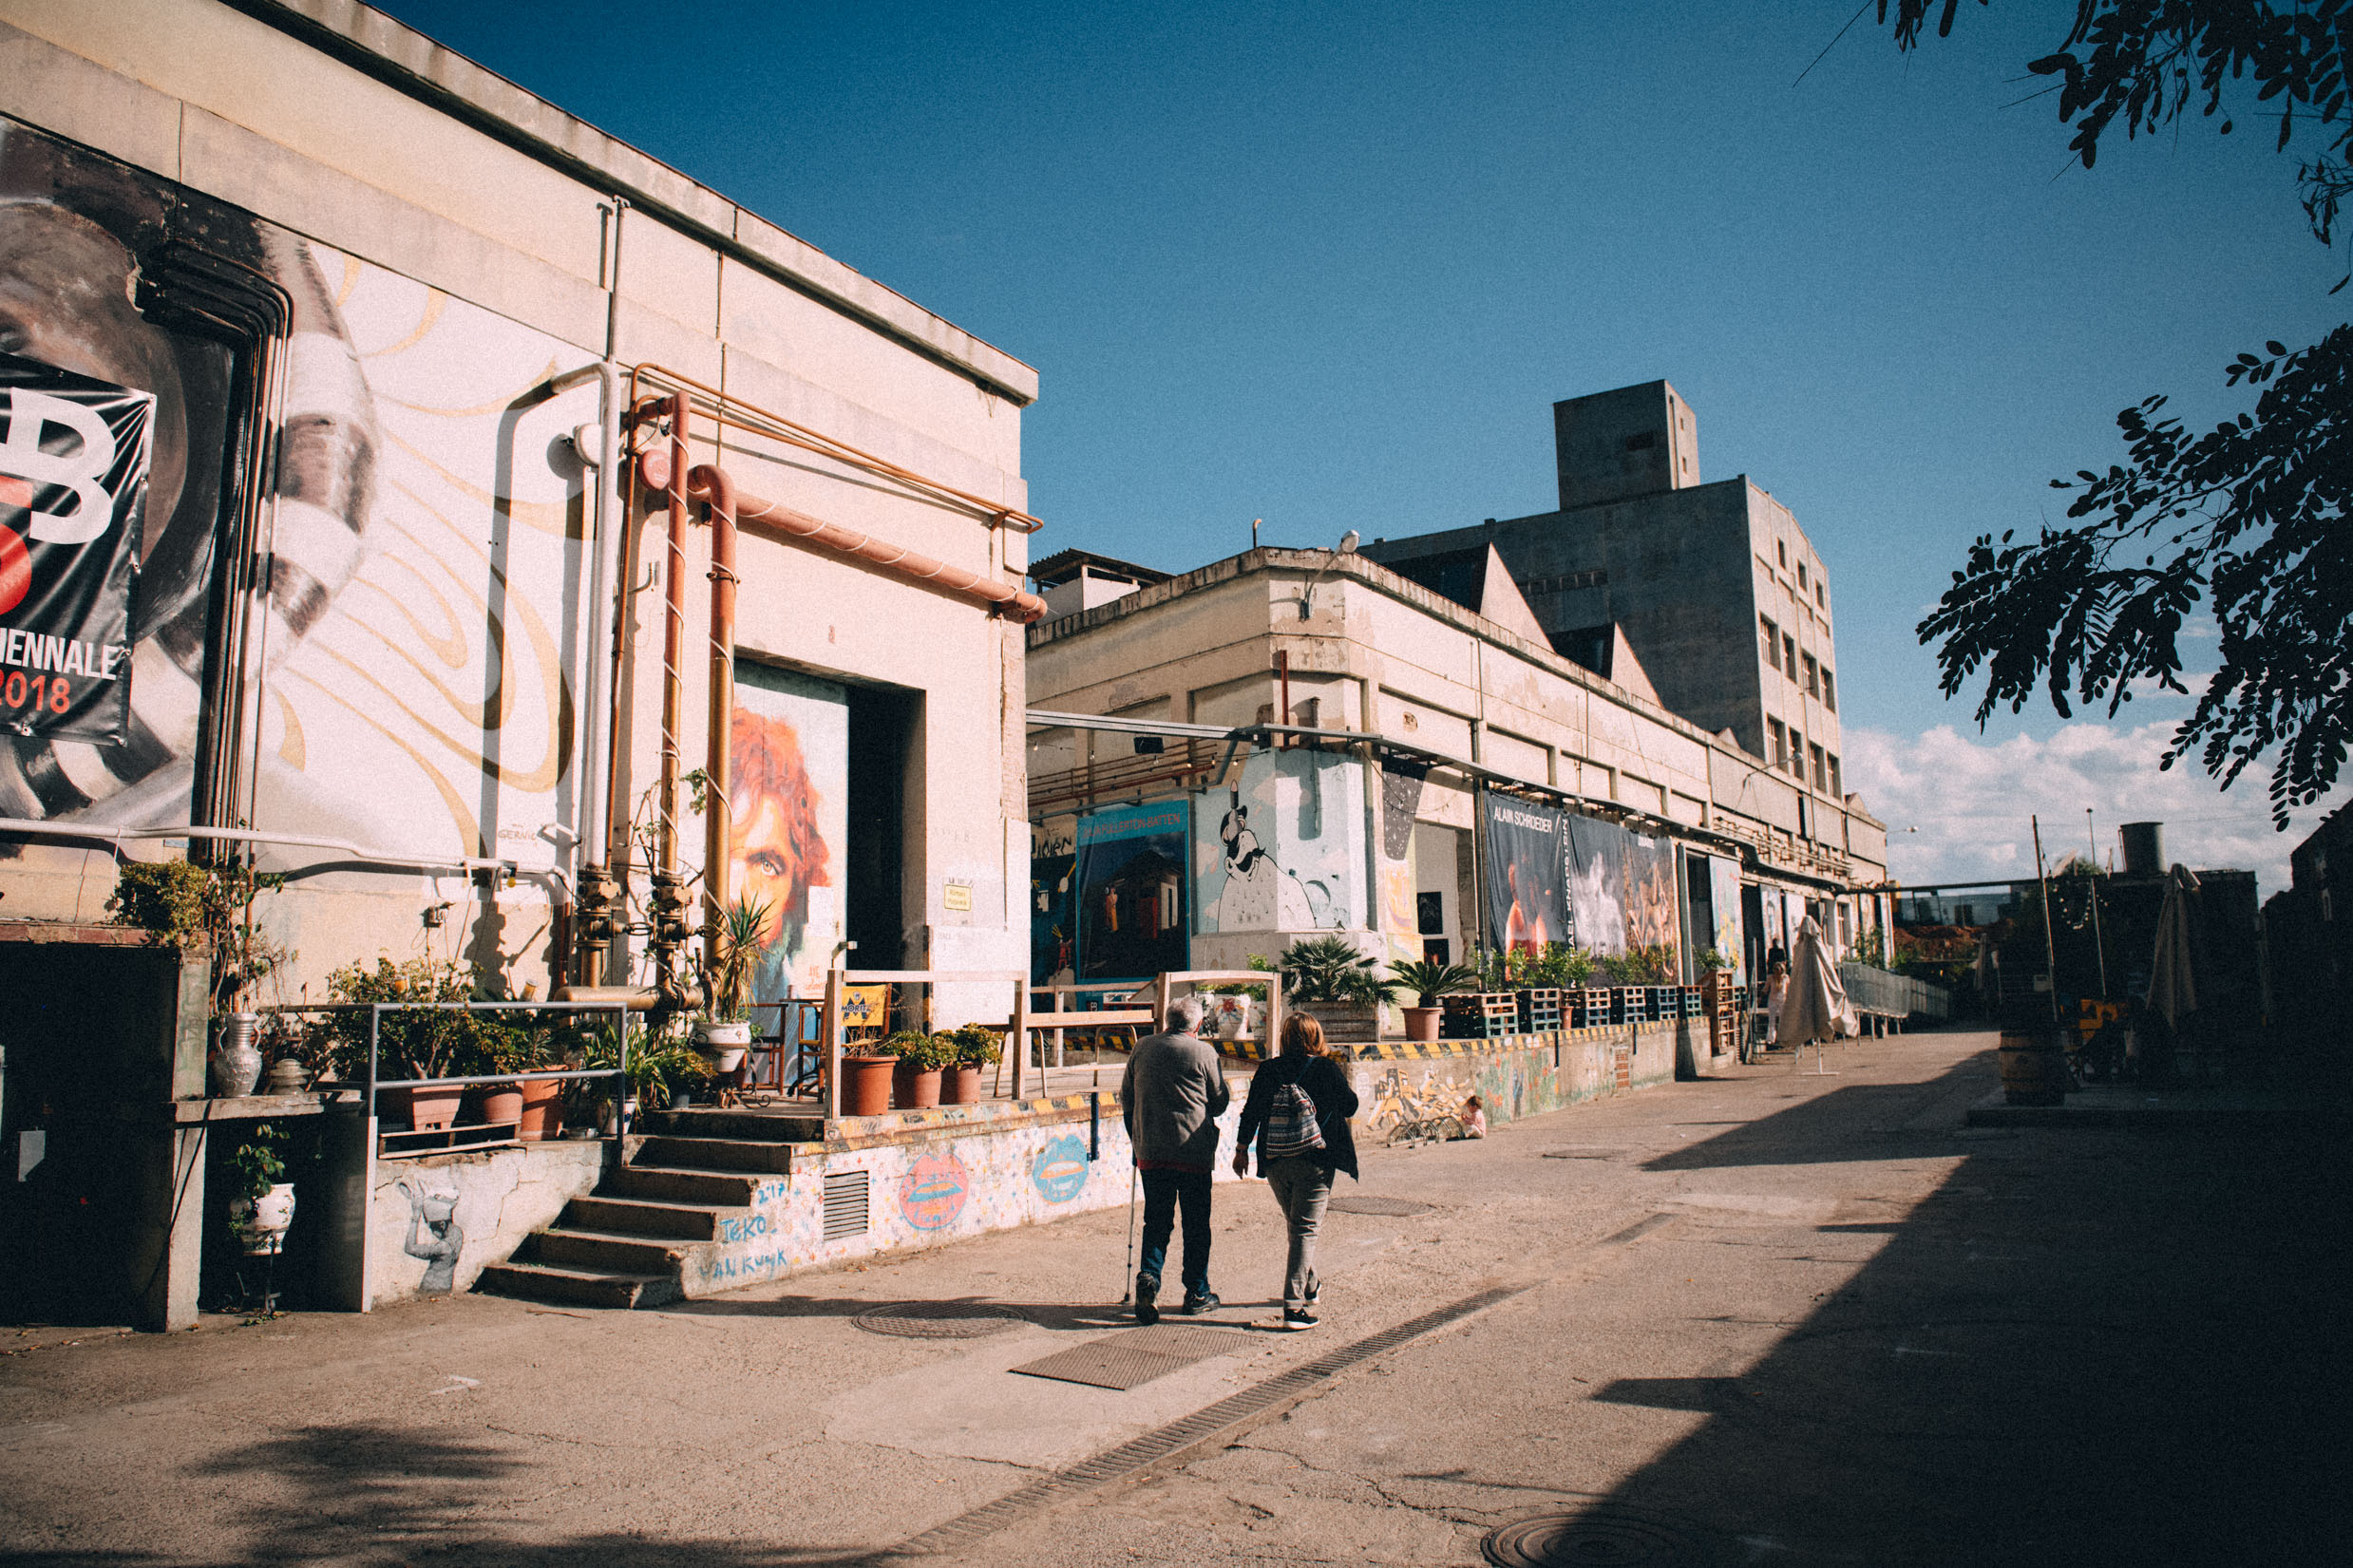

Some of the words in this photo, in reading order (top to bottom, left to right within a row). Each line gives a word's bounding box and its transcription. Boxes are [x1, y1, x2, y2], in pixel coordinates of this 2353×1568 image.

[0, 669, 70, 714] 018
[1493, 804, 1514, 824] ALAIN
[1514, 810, 1552, 834] SCHROEDER
[841, 1004, 872, 1013] MORITZ
